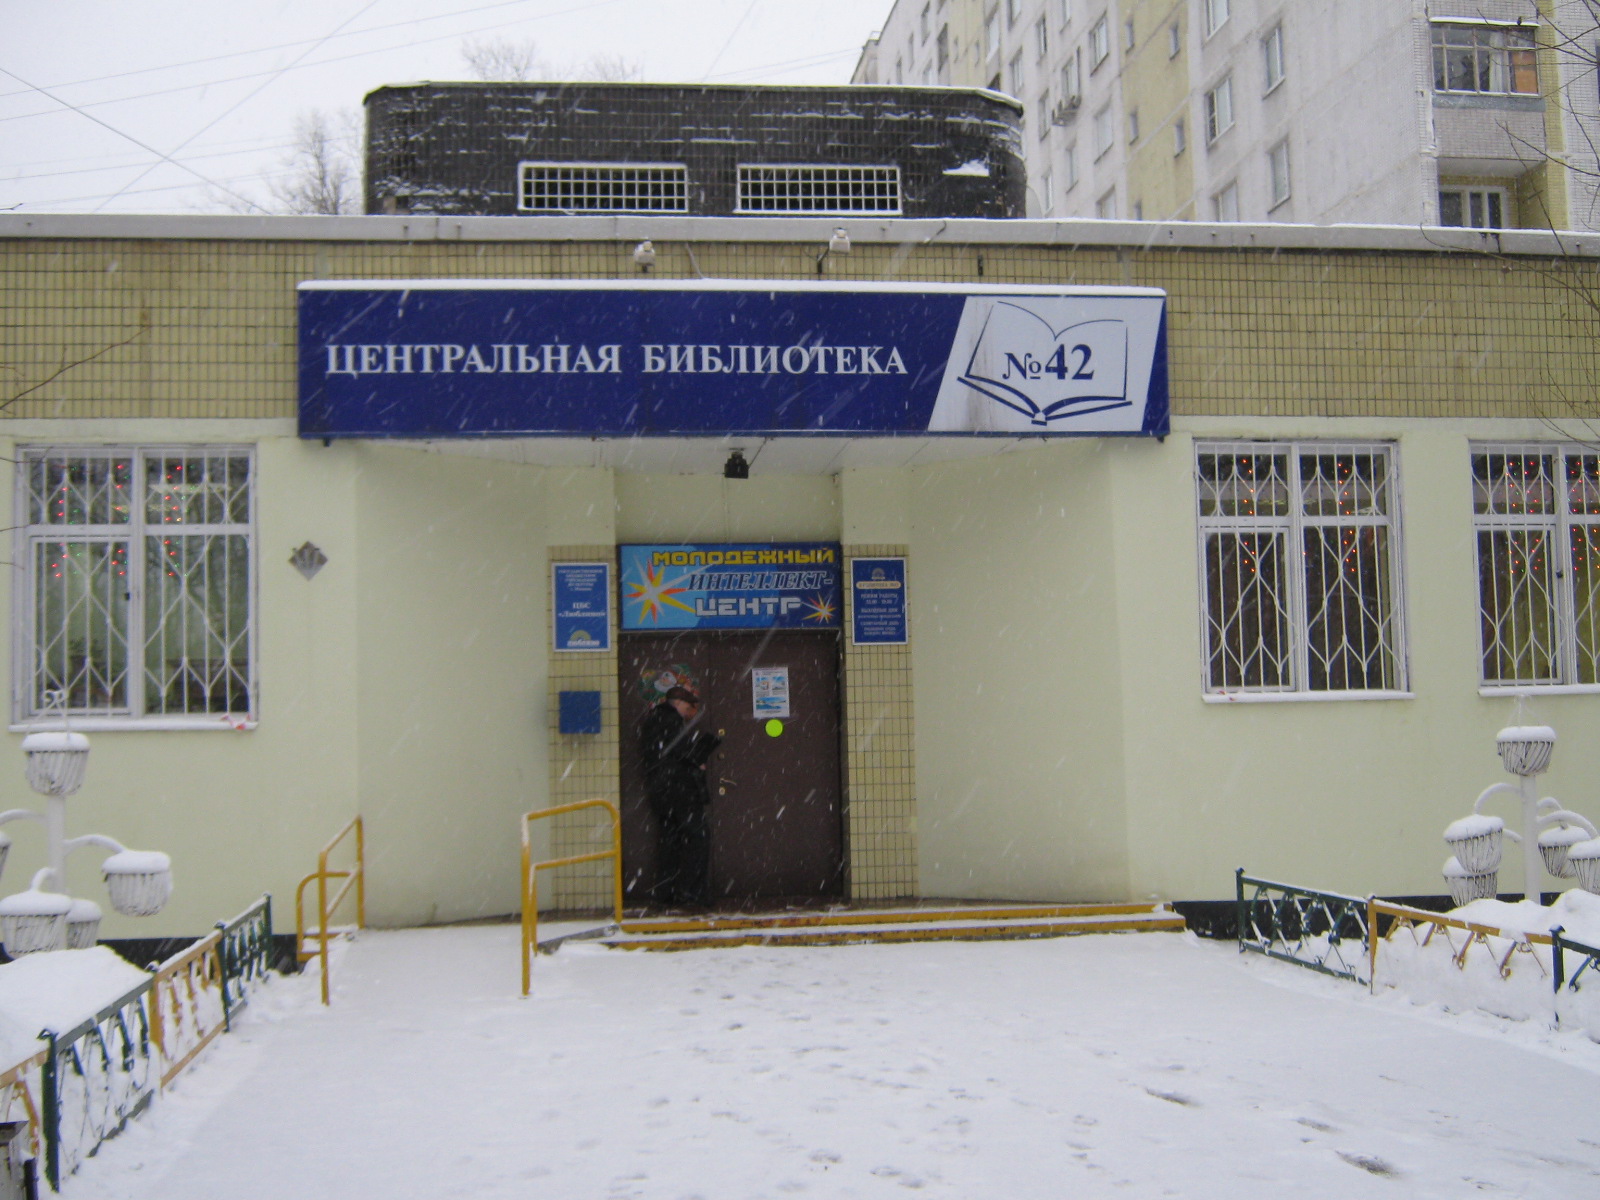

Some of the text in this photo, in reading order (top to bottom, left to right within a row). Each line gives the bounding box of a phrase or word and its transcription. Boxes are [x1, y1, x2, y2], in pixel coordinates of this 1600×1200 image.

[324, 343, 1095, 380] ЦЕНТРАЛЬНАЯ БИБЛИОТЕКА №42
[652, 547, 835, 566] МОЛОДЕЖНЫЙ
[687, 570, 834, 591] ИНТЕЛЛЕКТ-
[695, 597, 802, 616] ЦЕНТР
